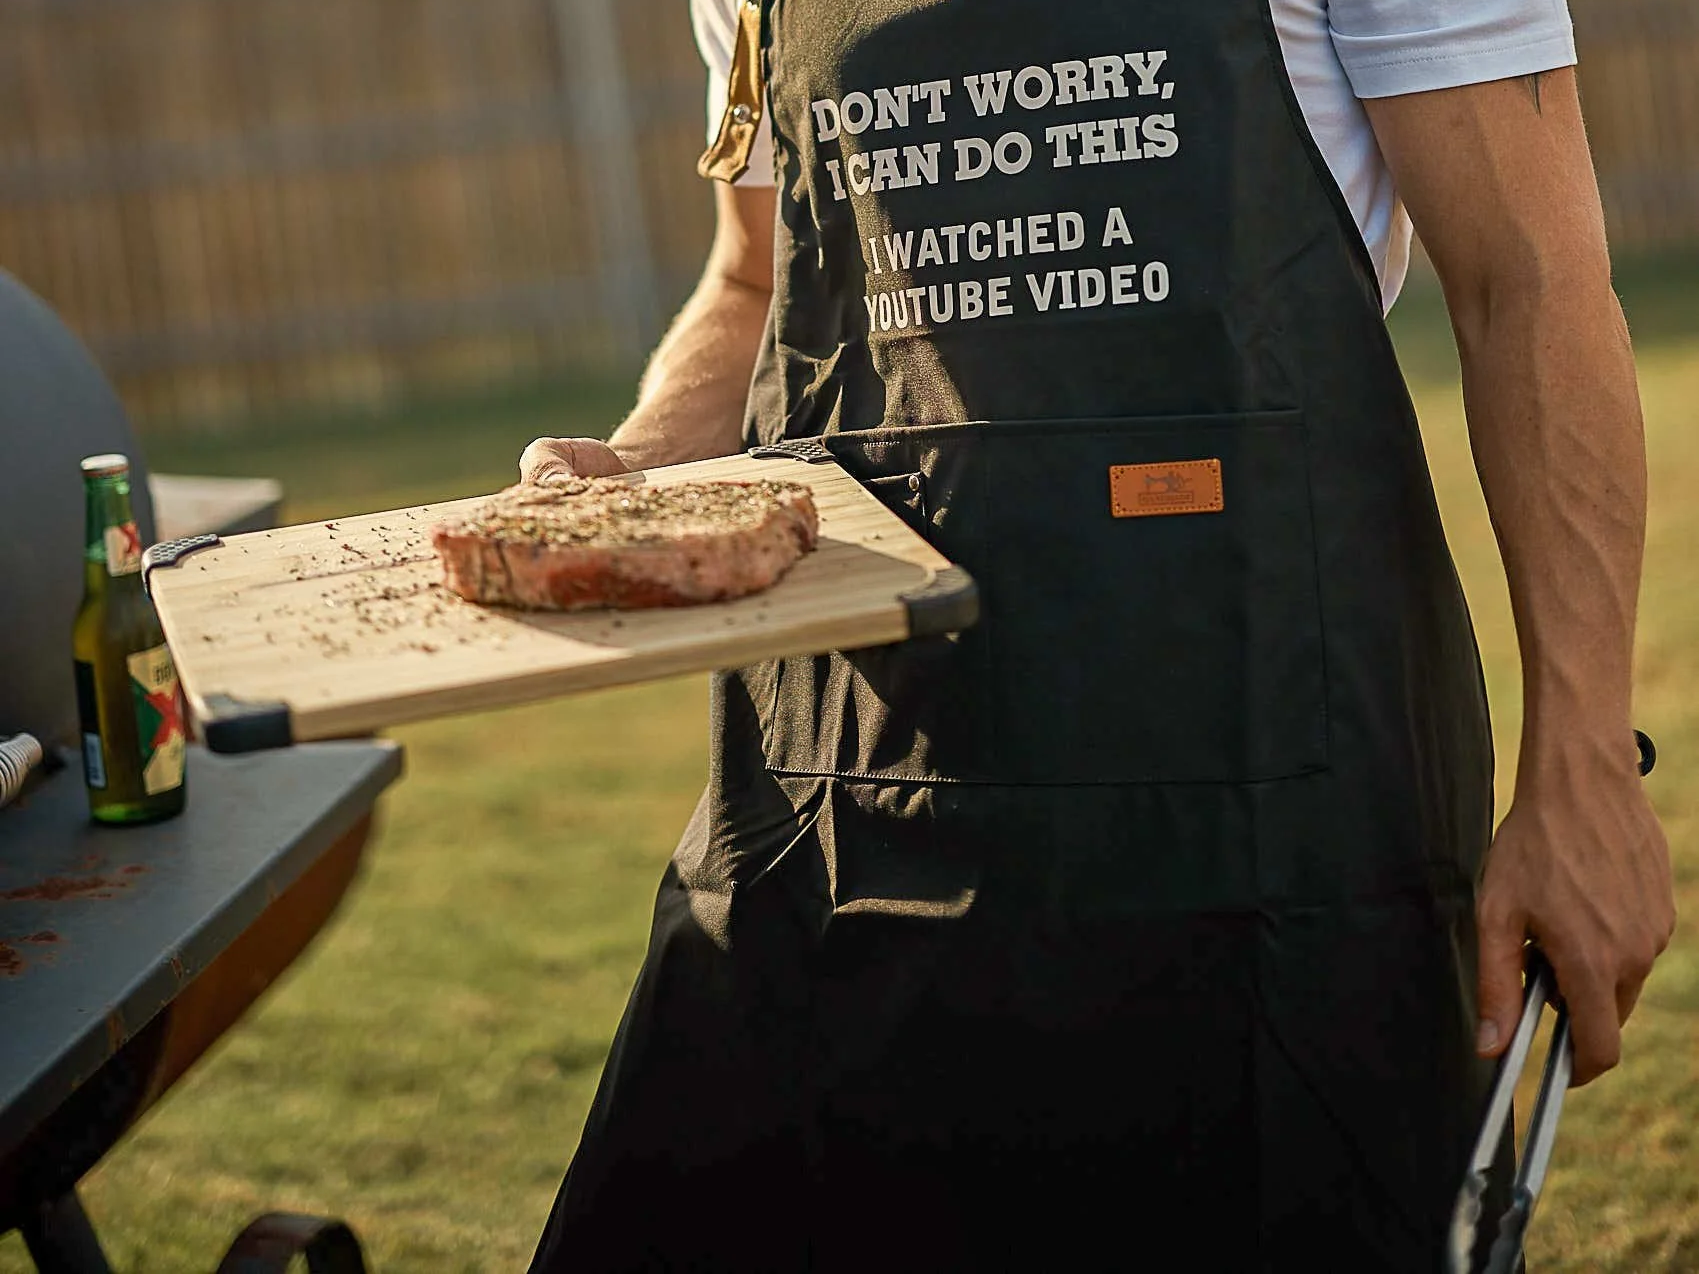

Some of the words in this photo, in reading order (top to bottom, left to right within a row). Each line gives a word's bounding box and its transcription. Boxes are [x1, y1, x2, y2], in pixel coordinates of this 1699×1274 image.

[811, 79, 951, 143] DON'T
[963, 50, 1175, 118] WORRY,
[826, 160, 847, 201] I
[847, 142, 941, 197] CAN
[953, 131, 1033, 182] DO
[1046, 113, 1180, 168] THIS
[868, 237, 883, 275] I
[885, 211, 1086, 274] WATCHED
[1101, 207, 1134, 247] A
[864, 276, 1014, 332] YOUTUBE
[1026, 261, 1171, 312] VIDEO
